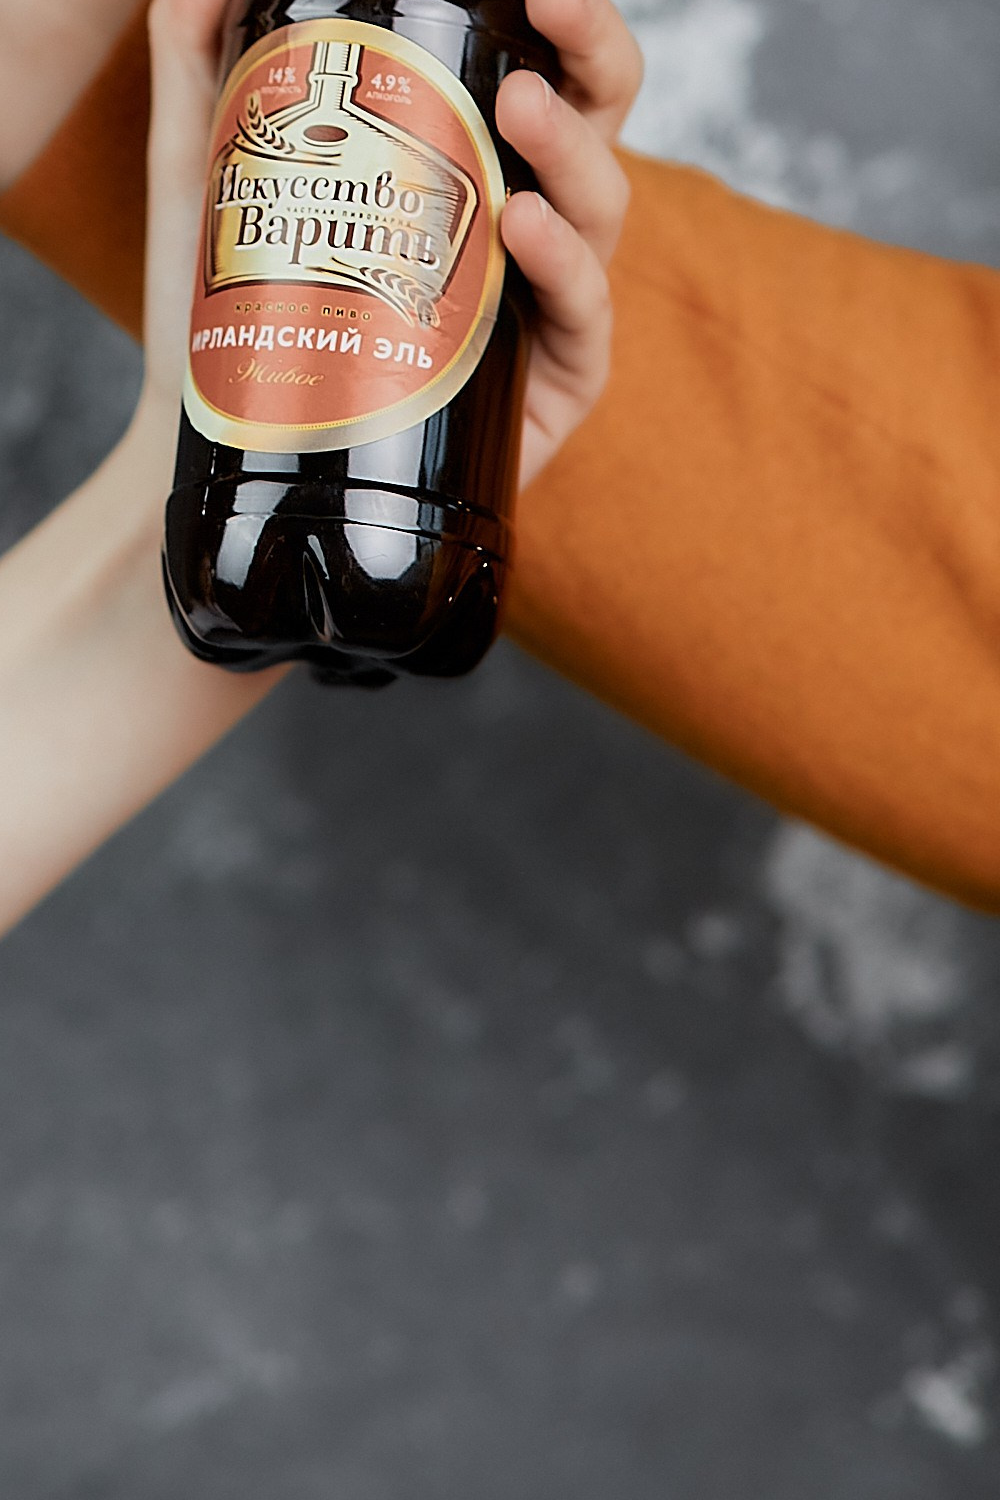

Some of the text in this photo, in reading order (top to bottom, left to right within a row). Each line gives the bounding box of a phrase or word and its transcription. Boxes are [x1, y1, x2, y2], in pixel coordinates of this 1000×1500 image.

[268, 66, 297, 85] 14%
[216, 162, 424, 218] Искусство
[233, 204, 440, 270] Варить
[235, 301, 372, 321] красное пиво
[191, 324, 434, 370] ИРЛАНДСКИЙ ЭЛЬ
